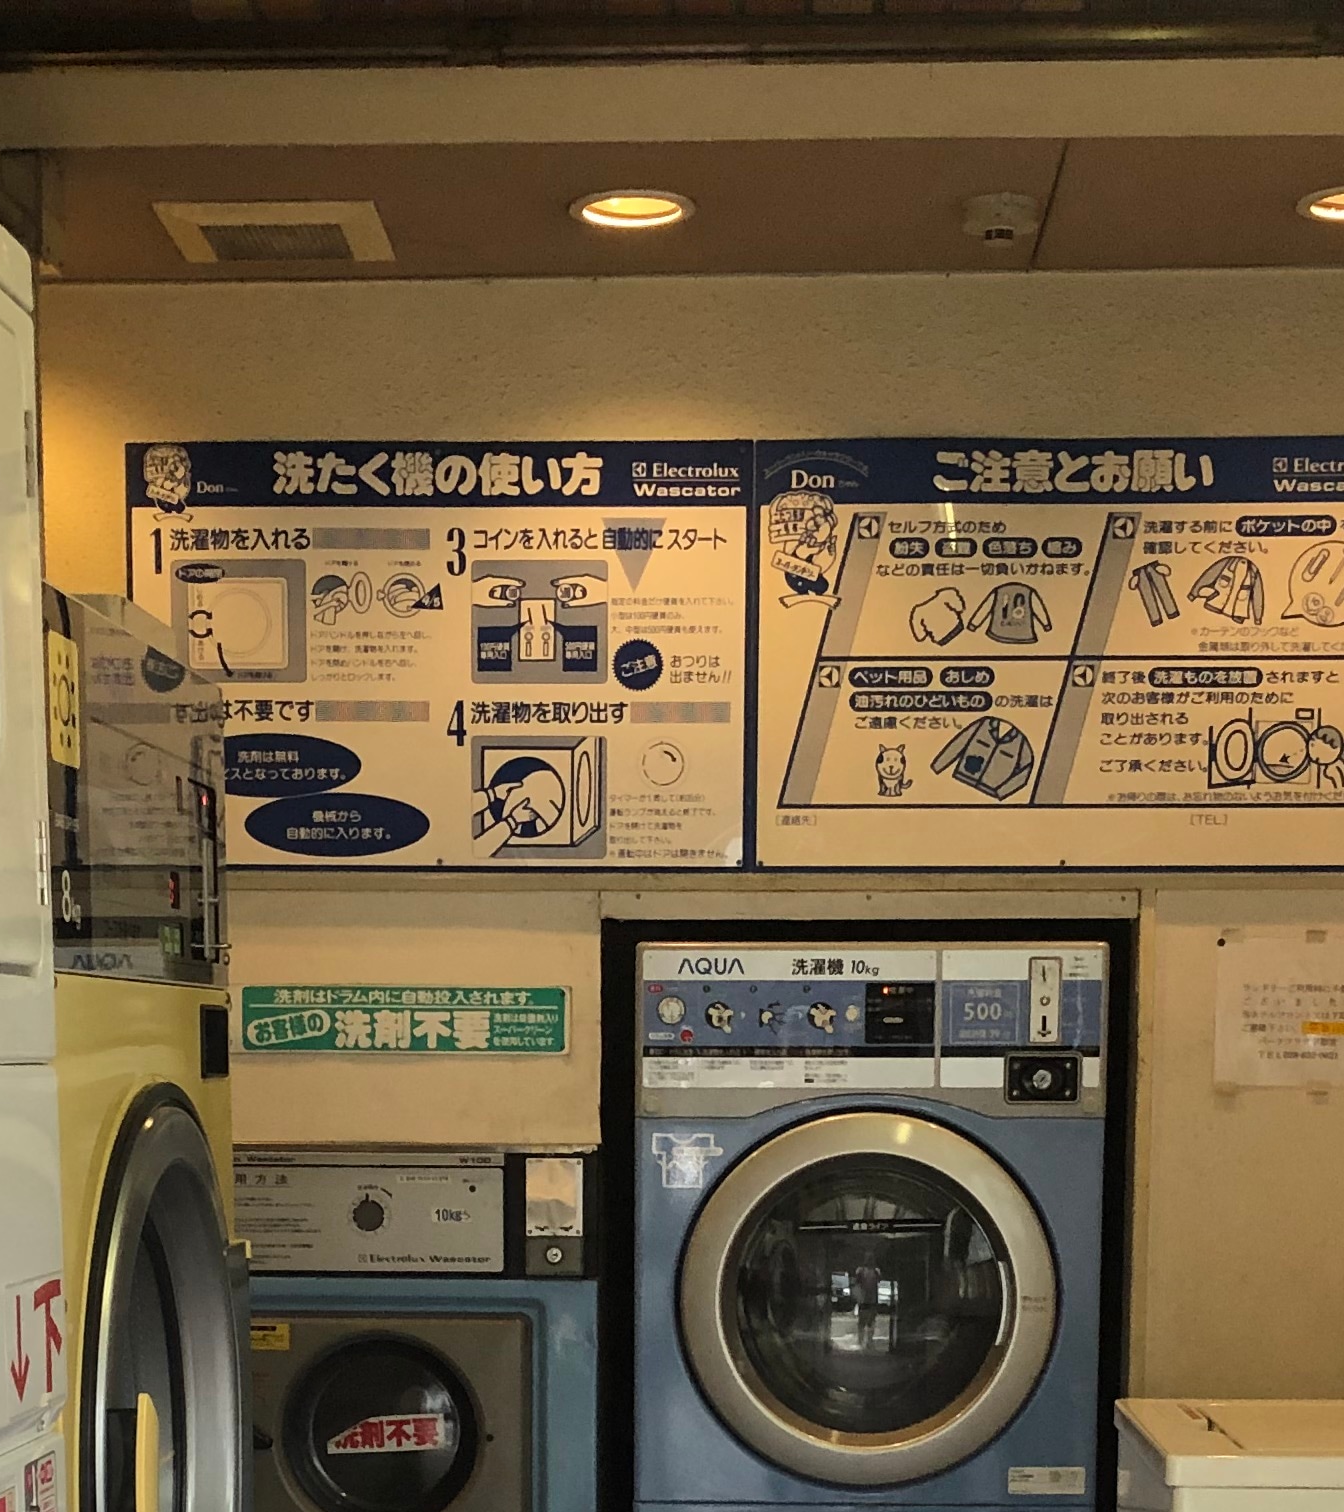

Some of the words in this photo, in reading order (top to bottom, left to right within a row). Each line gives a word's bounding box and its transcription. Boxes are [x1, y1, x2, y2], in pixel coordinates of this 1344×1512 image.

[273, 450, 603, 496] 洗たく機の使い方
[652, 462, 739, 478] Electrolux
[933, 448, 1214, 493] ご注意とお願い
[791, 470, 835, 489] Don
[196, 481, 224, 494] Don
[633, 483, 741, 497] Wascator
[1143, 520, 1233, 534] 洗濯する前に
[1239, 518, 1332, 533] ポケットの中
[150, 528, 162, 574] 1
[169, 528, 311, 551] 洗濯物を入れる
[446, 527, 467, 576] 3
[988, 541, 1033, 556] 色落ち
[1143, 541, 1269, 555] 確認してください。
[876, 563, 1090, 577] などの責任は一切負いかねます。
[670, 655, 721, 668] おつりは
[853, 670, 928, 684] ペット用品
[944, 669, 990, 684] おしめ
[1266, 670, 1340, 684] されますと
[854, 694, 986, 708] 油汚れのひどいもの
[994, 695, 1054, 708] の洗濯は
[1101, 691, 1295, 705] 次のお客様がご利用のために
[447, 700, 467, 746] 4
[471, 701, 628, 724] 洗濯物を取り出す
[854, 716, 963, 730] ご遠慮ください。
[1101, 711, 1189, 725] 取り出される
[1099, 732, 1209, 746] ことがあります。
[1099, 759, 1208, 773] ご了承ください。
[678, 958, 745, 975] AQUA
[792, 958, 844, 976] 洗濯機
[850, 959, 880, 977] 10kg
[963, 1002, 1002, 1021] 500
[255, 1013, 324, 1040] お客様の
[335, 1010, 490, 1049] 洗剤不要
